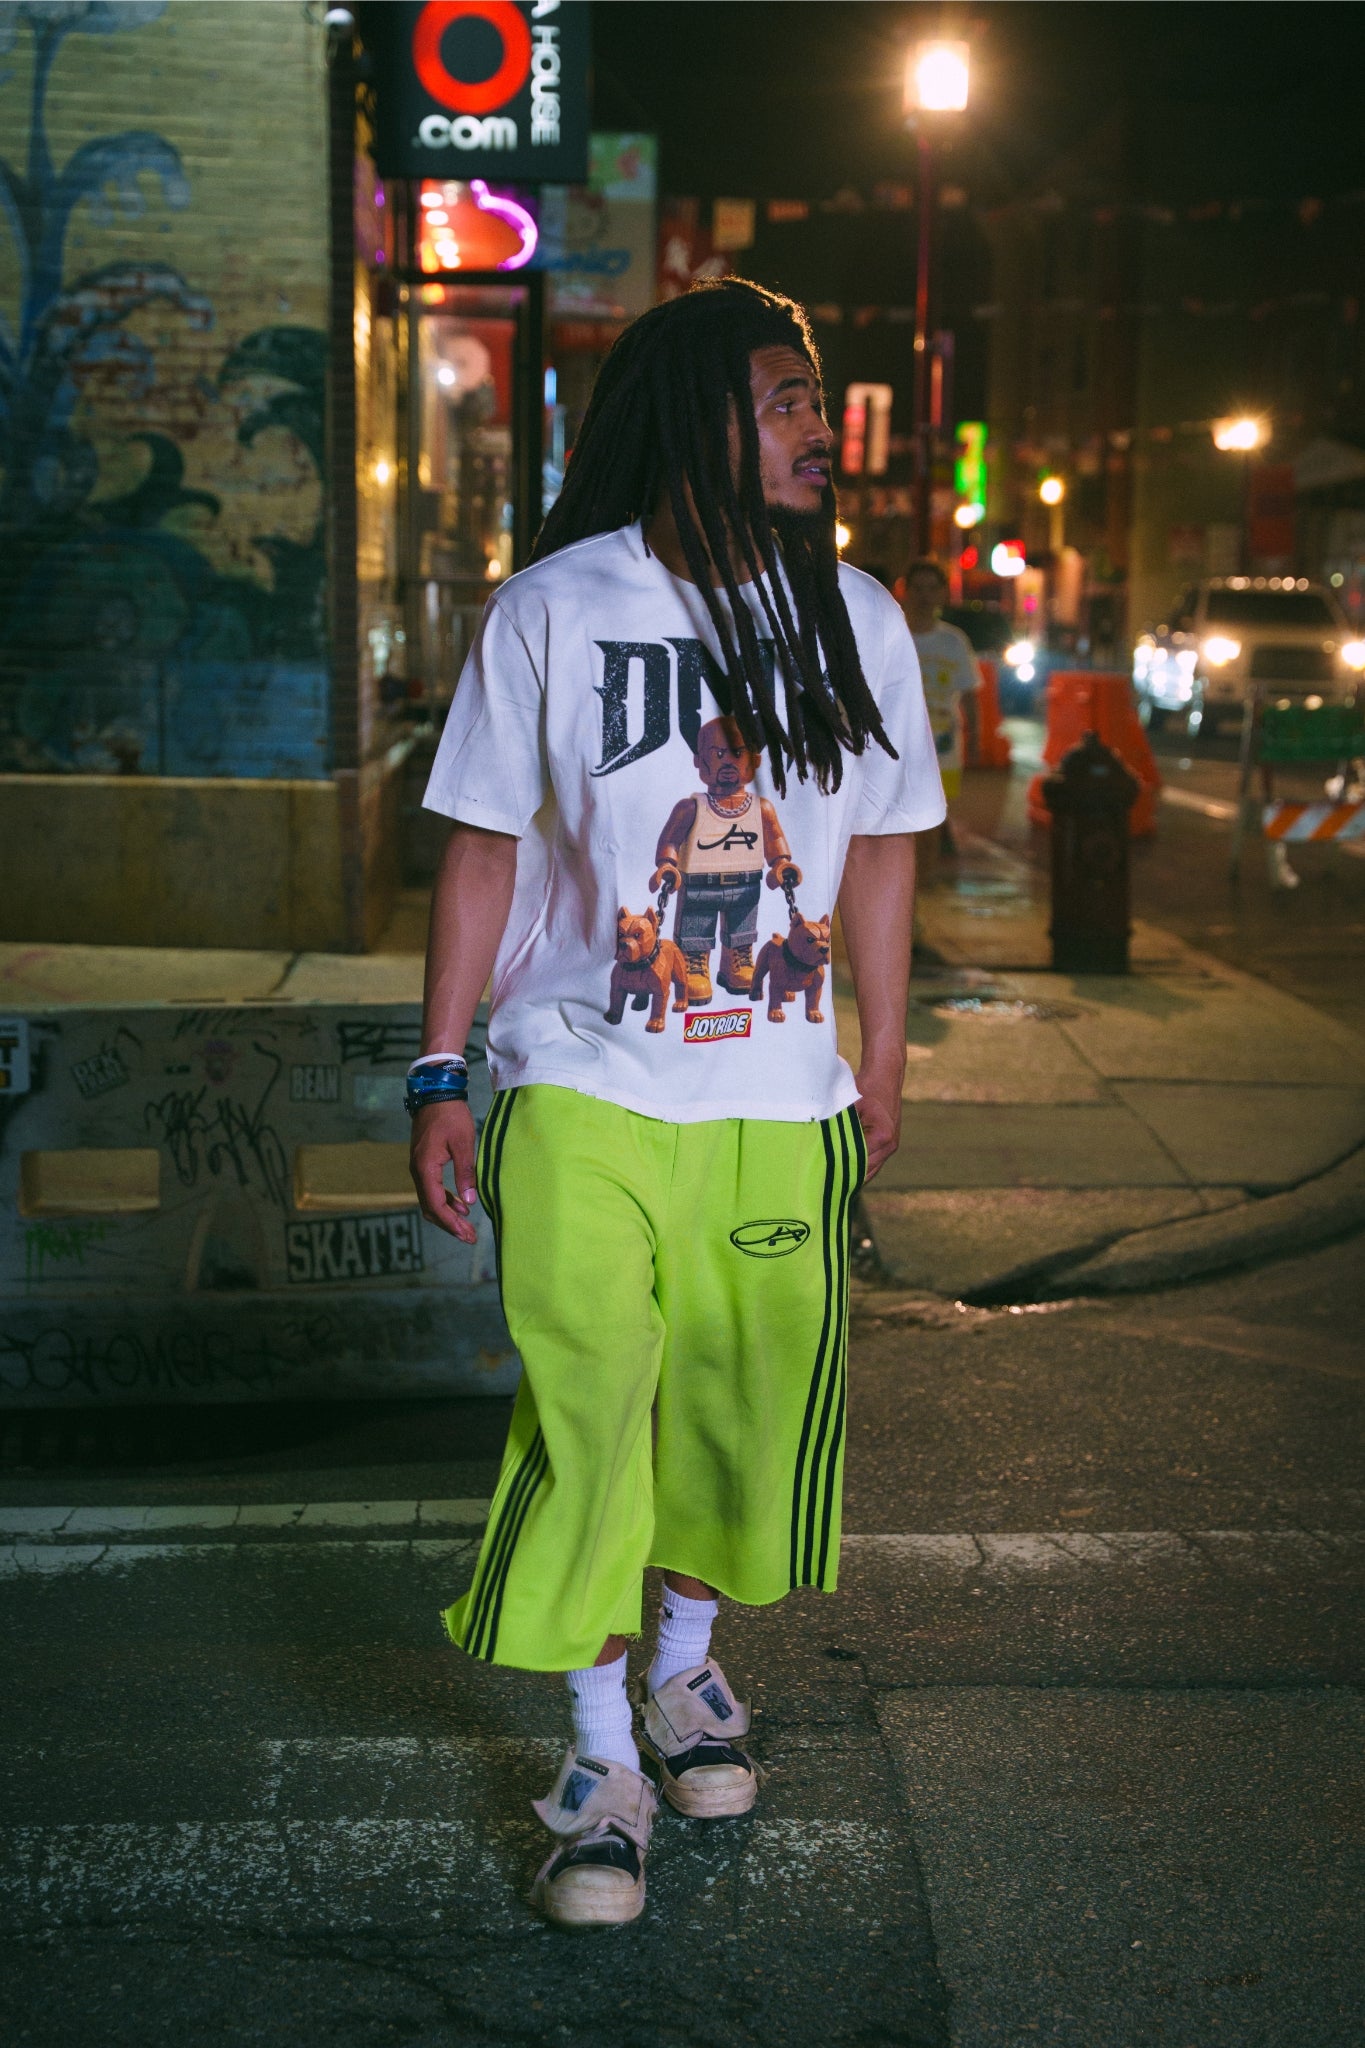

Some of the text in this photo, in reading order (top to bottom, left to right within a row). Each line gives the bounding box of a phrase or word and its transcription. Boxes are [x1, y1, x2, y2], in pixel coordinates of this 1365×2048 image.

[530, 25, 561, 146] HOUSE
[686, 1013, 749, 1038] JOYRIDE
[287, 1213, 422, 1282] SKATE!
